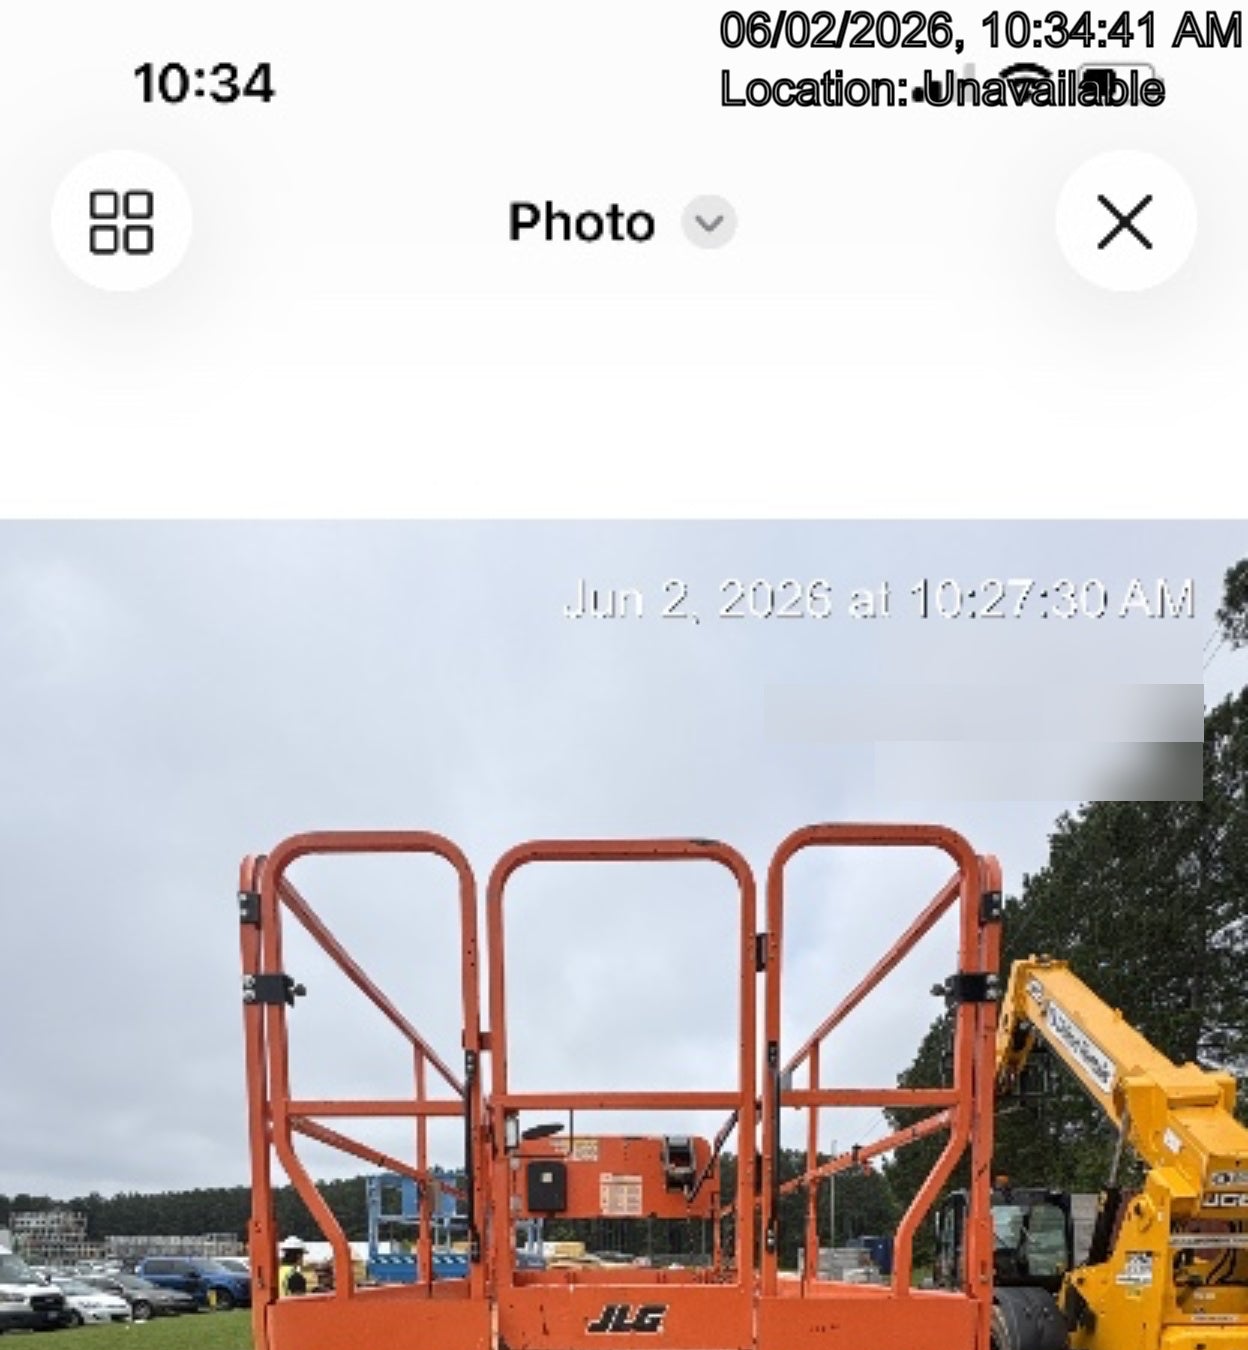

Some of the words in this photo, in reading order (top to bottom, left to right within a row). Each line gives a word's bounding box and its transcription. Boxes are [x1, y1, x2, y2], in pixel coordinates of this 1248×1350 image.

[134, 62, 276, 104] 10:34
[509, 201, 656, 242] Photo
[584, 1302, 670, 1336] JLG
